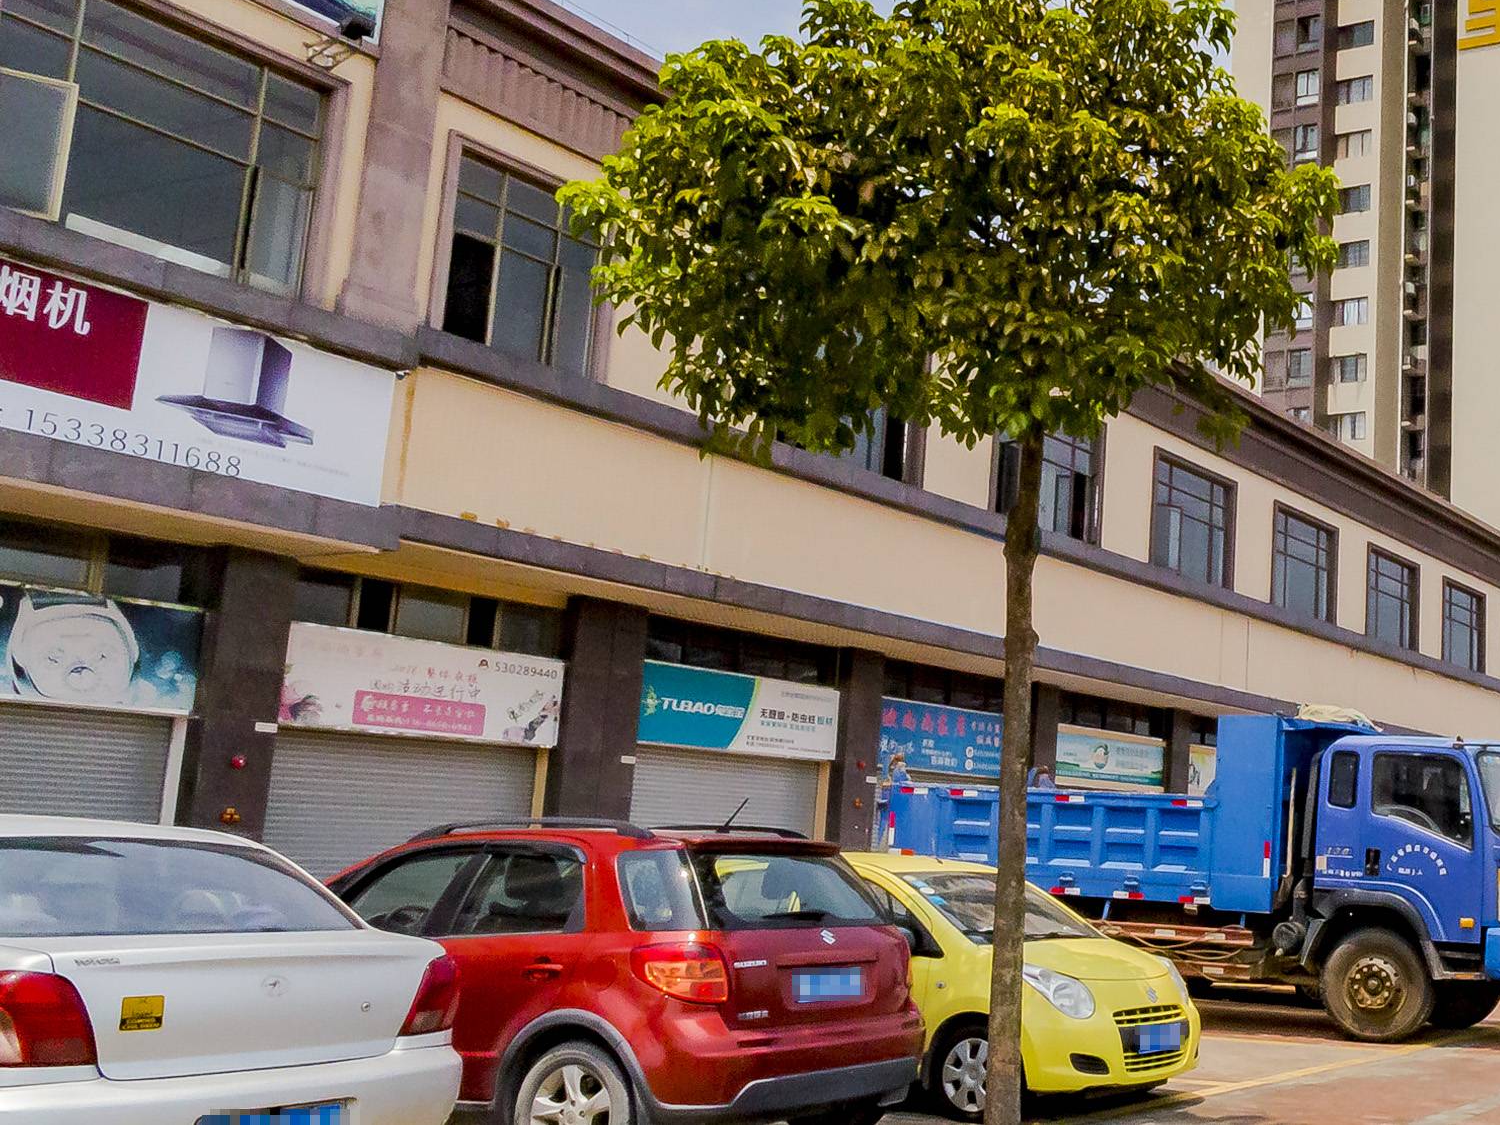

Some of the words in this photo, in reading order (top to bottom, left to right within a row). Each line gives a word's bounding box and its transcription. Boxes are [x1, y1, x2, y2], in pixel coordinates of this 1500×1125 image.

[0, 265, 90, 335] 烟机
[25, 409, 242, 477] 15338311688
[494, 661, 558, 680] 530289440
